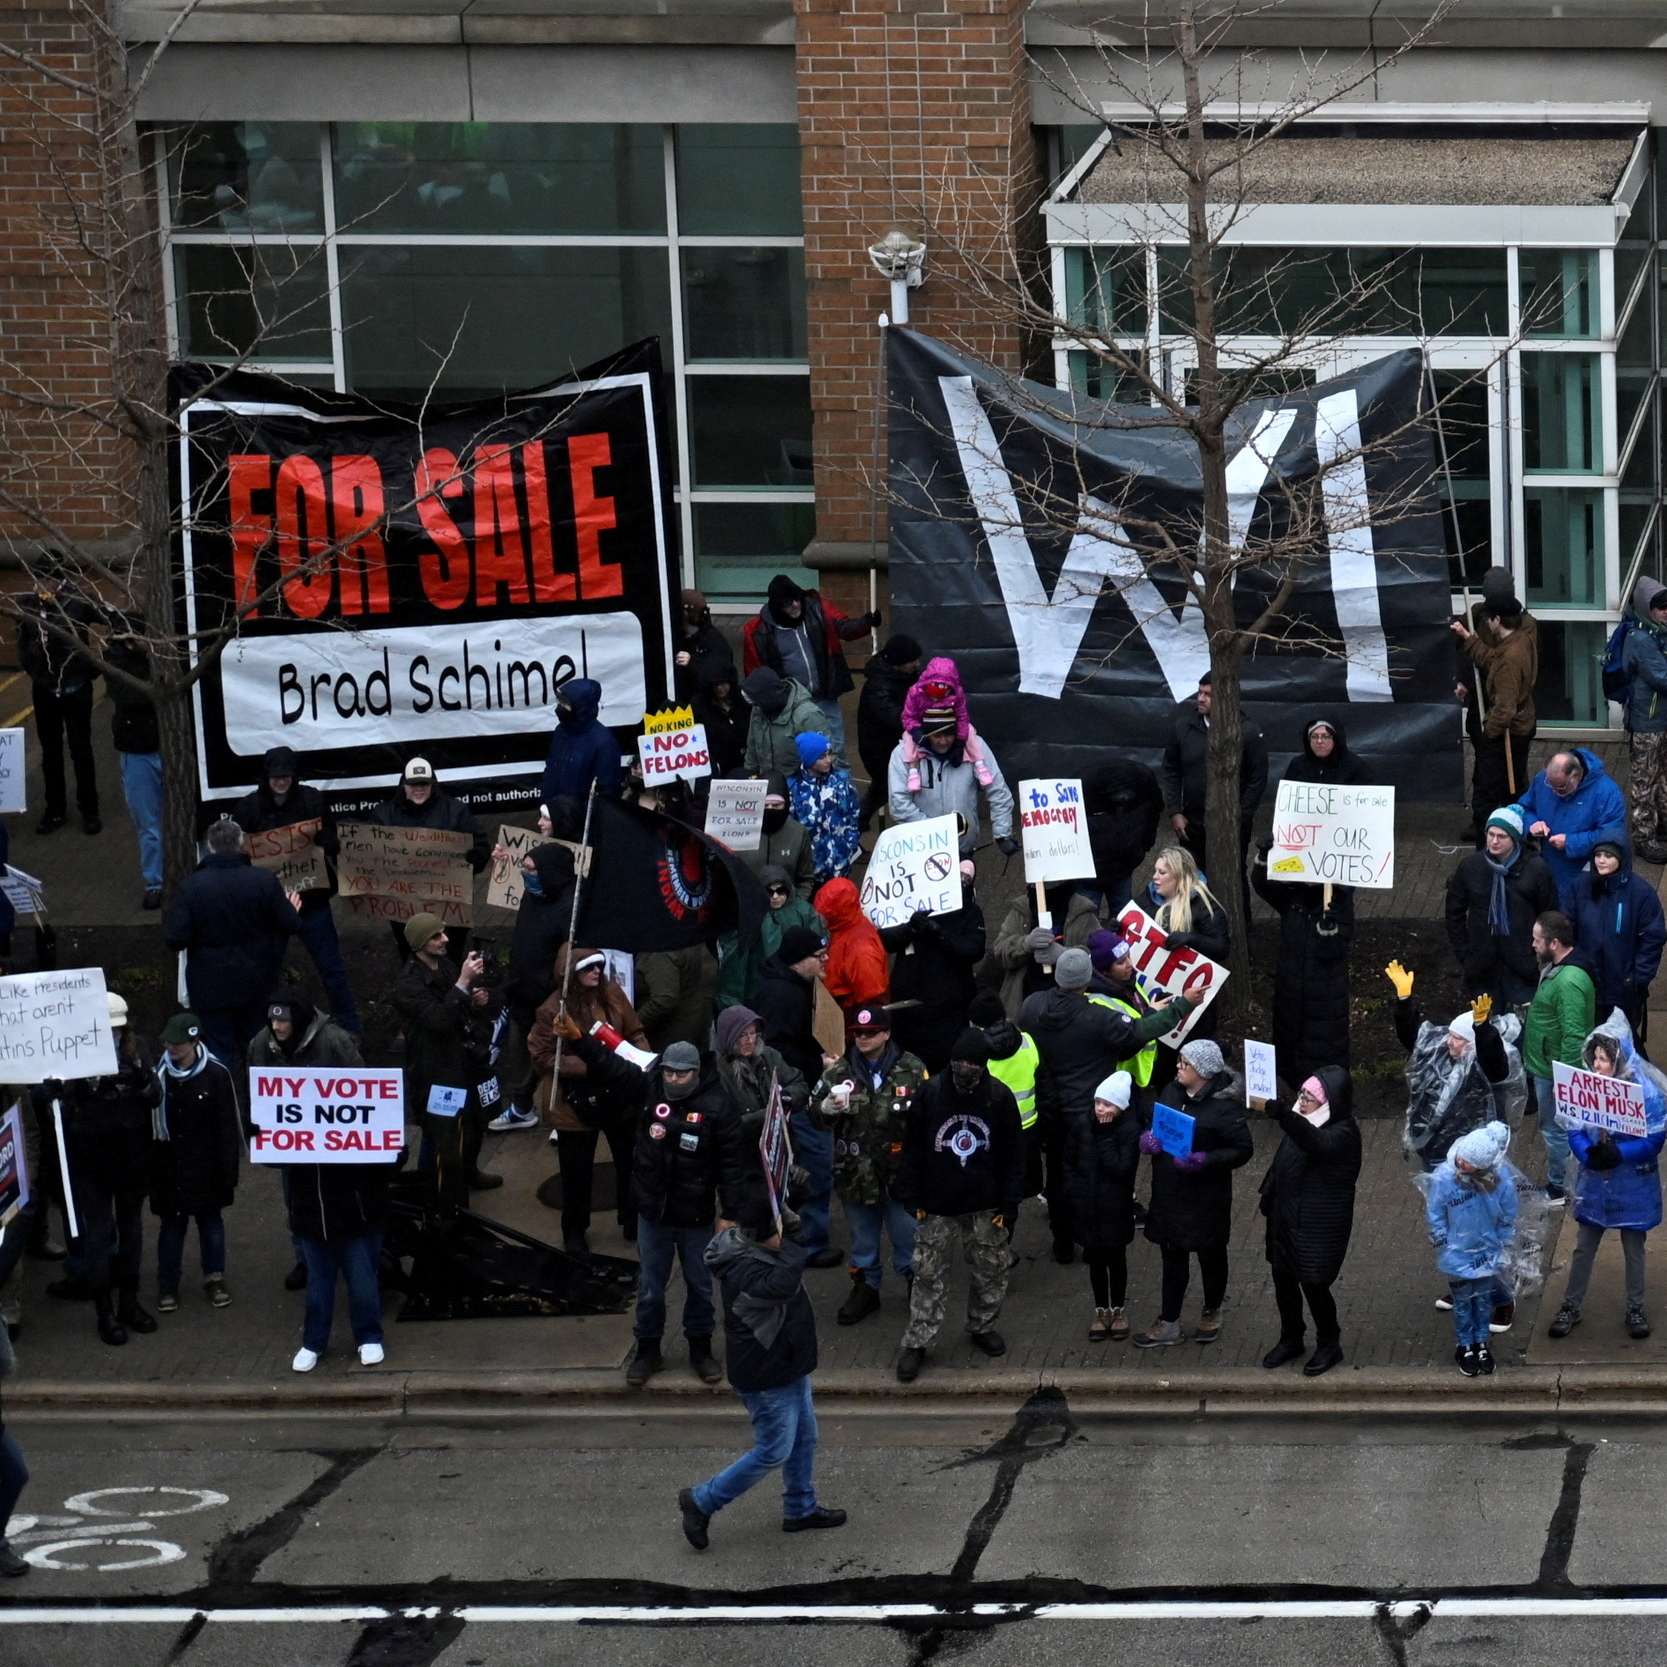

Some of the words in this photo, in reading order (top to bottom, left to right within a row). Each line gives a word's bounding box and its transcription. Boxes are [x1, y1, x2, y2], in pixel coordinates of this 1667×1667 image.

[227, 452, 390, 620] FOR
[415, 432, 624, 609] SALE
[278, 653, 391, 725] Brad
[409, 630, 590, 714] Schimel
[653, 733, 689, 753] NO
[644, 749, 709, 774] FELONS
[717, 800, 727, 809] IS
[735, 800, 759, 810] NOT
[1278, 783, 1338, 815] CHEESE
[1277, 825, 1323, 846] NOT
[1334, 827, 1371, 850] OUR
[889, 861, 906, 879] IS
[1308, 851, 1391, 883] VOTES!
[874, 873, 916, 903] NOT
[904, 891, 953, 914] SALE
[257, 1077, 306, 1098] MY
[313, 1079, 398, 1099] VOTE
[1571, 1072, 1631, 1099] ARREST
[276, 1104, 303, 1123] IS
[314, 1105, 376, 1124] NOT
[1558, 1083, 1600, 1113] ELON
[1605, 1098, 1645, 1120] MUSK
[254, 1129, 315, 1151] FOR
[323, 1130, 402, 1151] SALE
